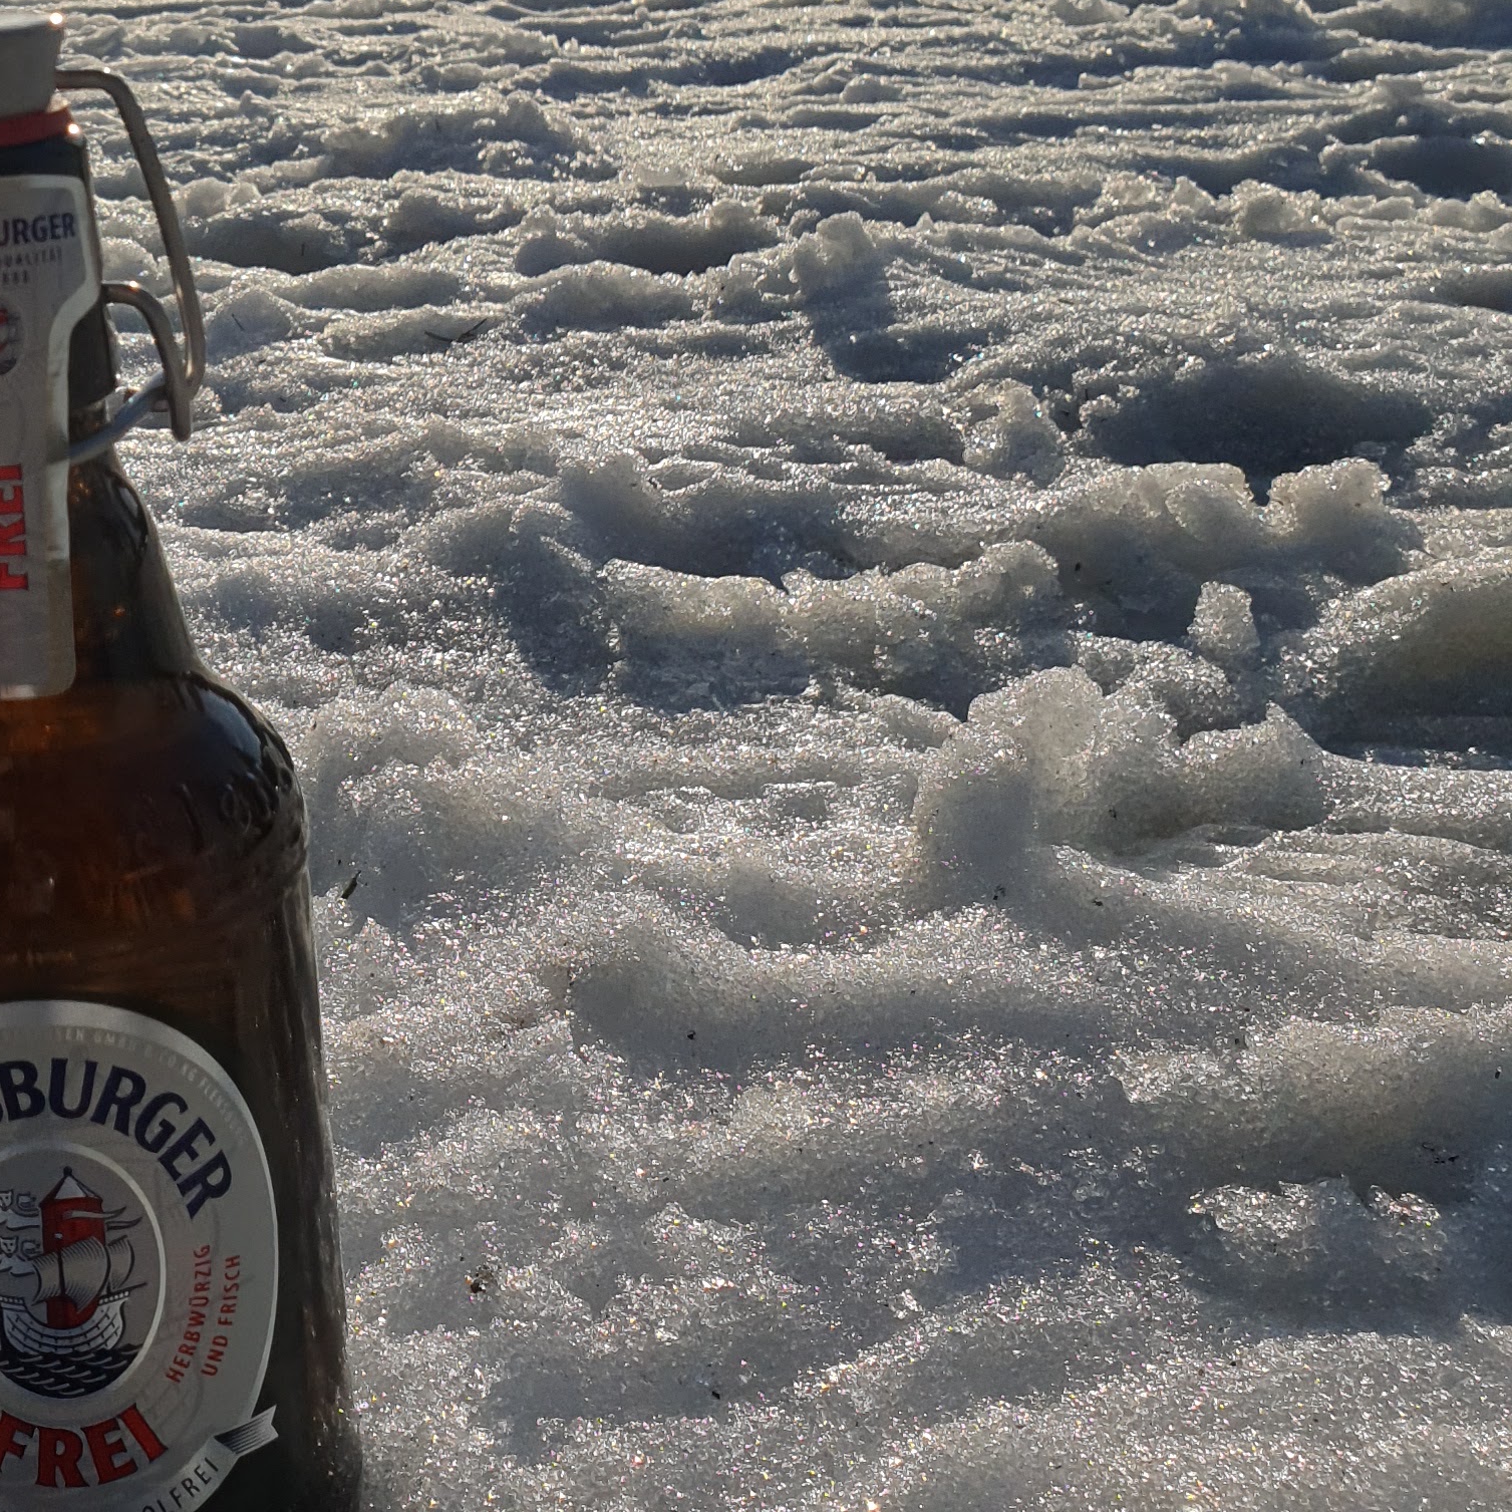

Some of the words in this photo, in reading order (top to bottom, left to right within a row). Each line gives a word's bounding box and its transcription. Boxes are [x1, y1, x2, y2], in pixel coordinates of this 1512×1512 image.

[165, 1244, 212, 1384] HERBWÜRZIG
[200, 1334, 229, 1377] UND
[217, 1254, 241, 1327] FRISCH
